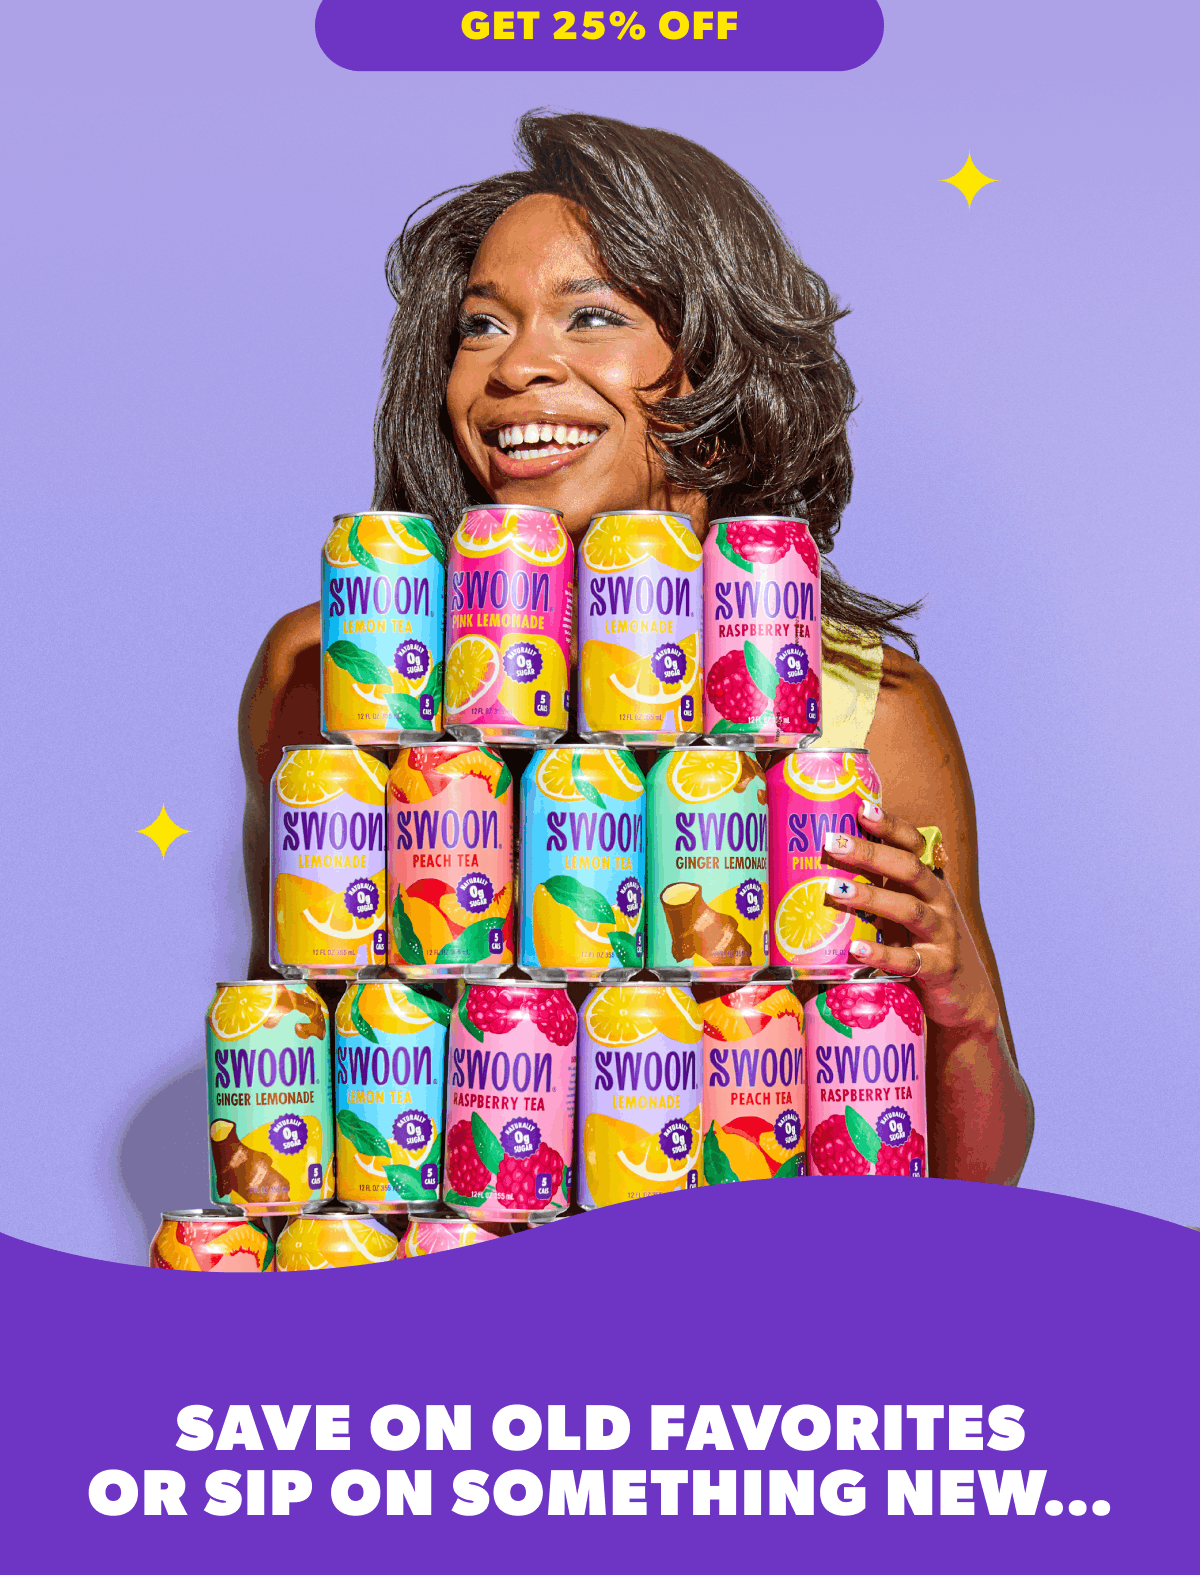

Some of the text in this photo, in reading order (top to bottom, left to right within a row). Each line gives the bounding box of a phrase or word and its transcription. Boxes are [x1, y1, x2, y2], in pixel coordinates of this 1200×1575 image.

[330, 575, 430, 617] SWOON
[451, 570, 549, 612] SWOON
[589, 576, 690, 617] SWOON
[715, 580, 814, 621] SWOON
[343, 619, 412, 634] LEMON TEA
[452, 614, 545, 630] PINK LEMONADE
[605, 619, 674, 634] LEMONADE
[719, 624, 810, 639] RASPBERRY TEA
[282, 811, 383, 851] SWOON
[396, 809, 498, 851] SWOON
[546, 811, 643, 853] SWOON
[675, 812, 768, 852] SWOON
[298, 854, 366, 869] LEMONADE
[413, 854, 479, 868] PEACH TEA
[565, 855, 632, 870] LEMON TEA
[675, 856, 720, 870] GINGER
[792, 856, 821, 870] PINK
[215, 1047, 315, 1089] SWOON
[337, 1045, 432, 1086] SWOON
[452, 1047, 552, 1093] SWOON
[595, 1051, 696, 1091] SWOON
[709, 1047, 803, 1088] SWOON
[816, 1043, 916, 1084] SWOON
[216, 1090, 315, 1107] GINGER LEMONADE
[346, 1090, 412, 1104] LEMON TEA
[453, 1092, 545, 1111] RASPBERRY TEA
[612, 1095, 681, 1109] LEMONADE
[730, 1091, 793, 1106] PEACH TEA
[820, 1086, 913, 1103] RASPBERRY TEA
